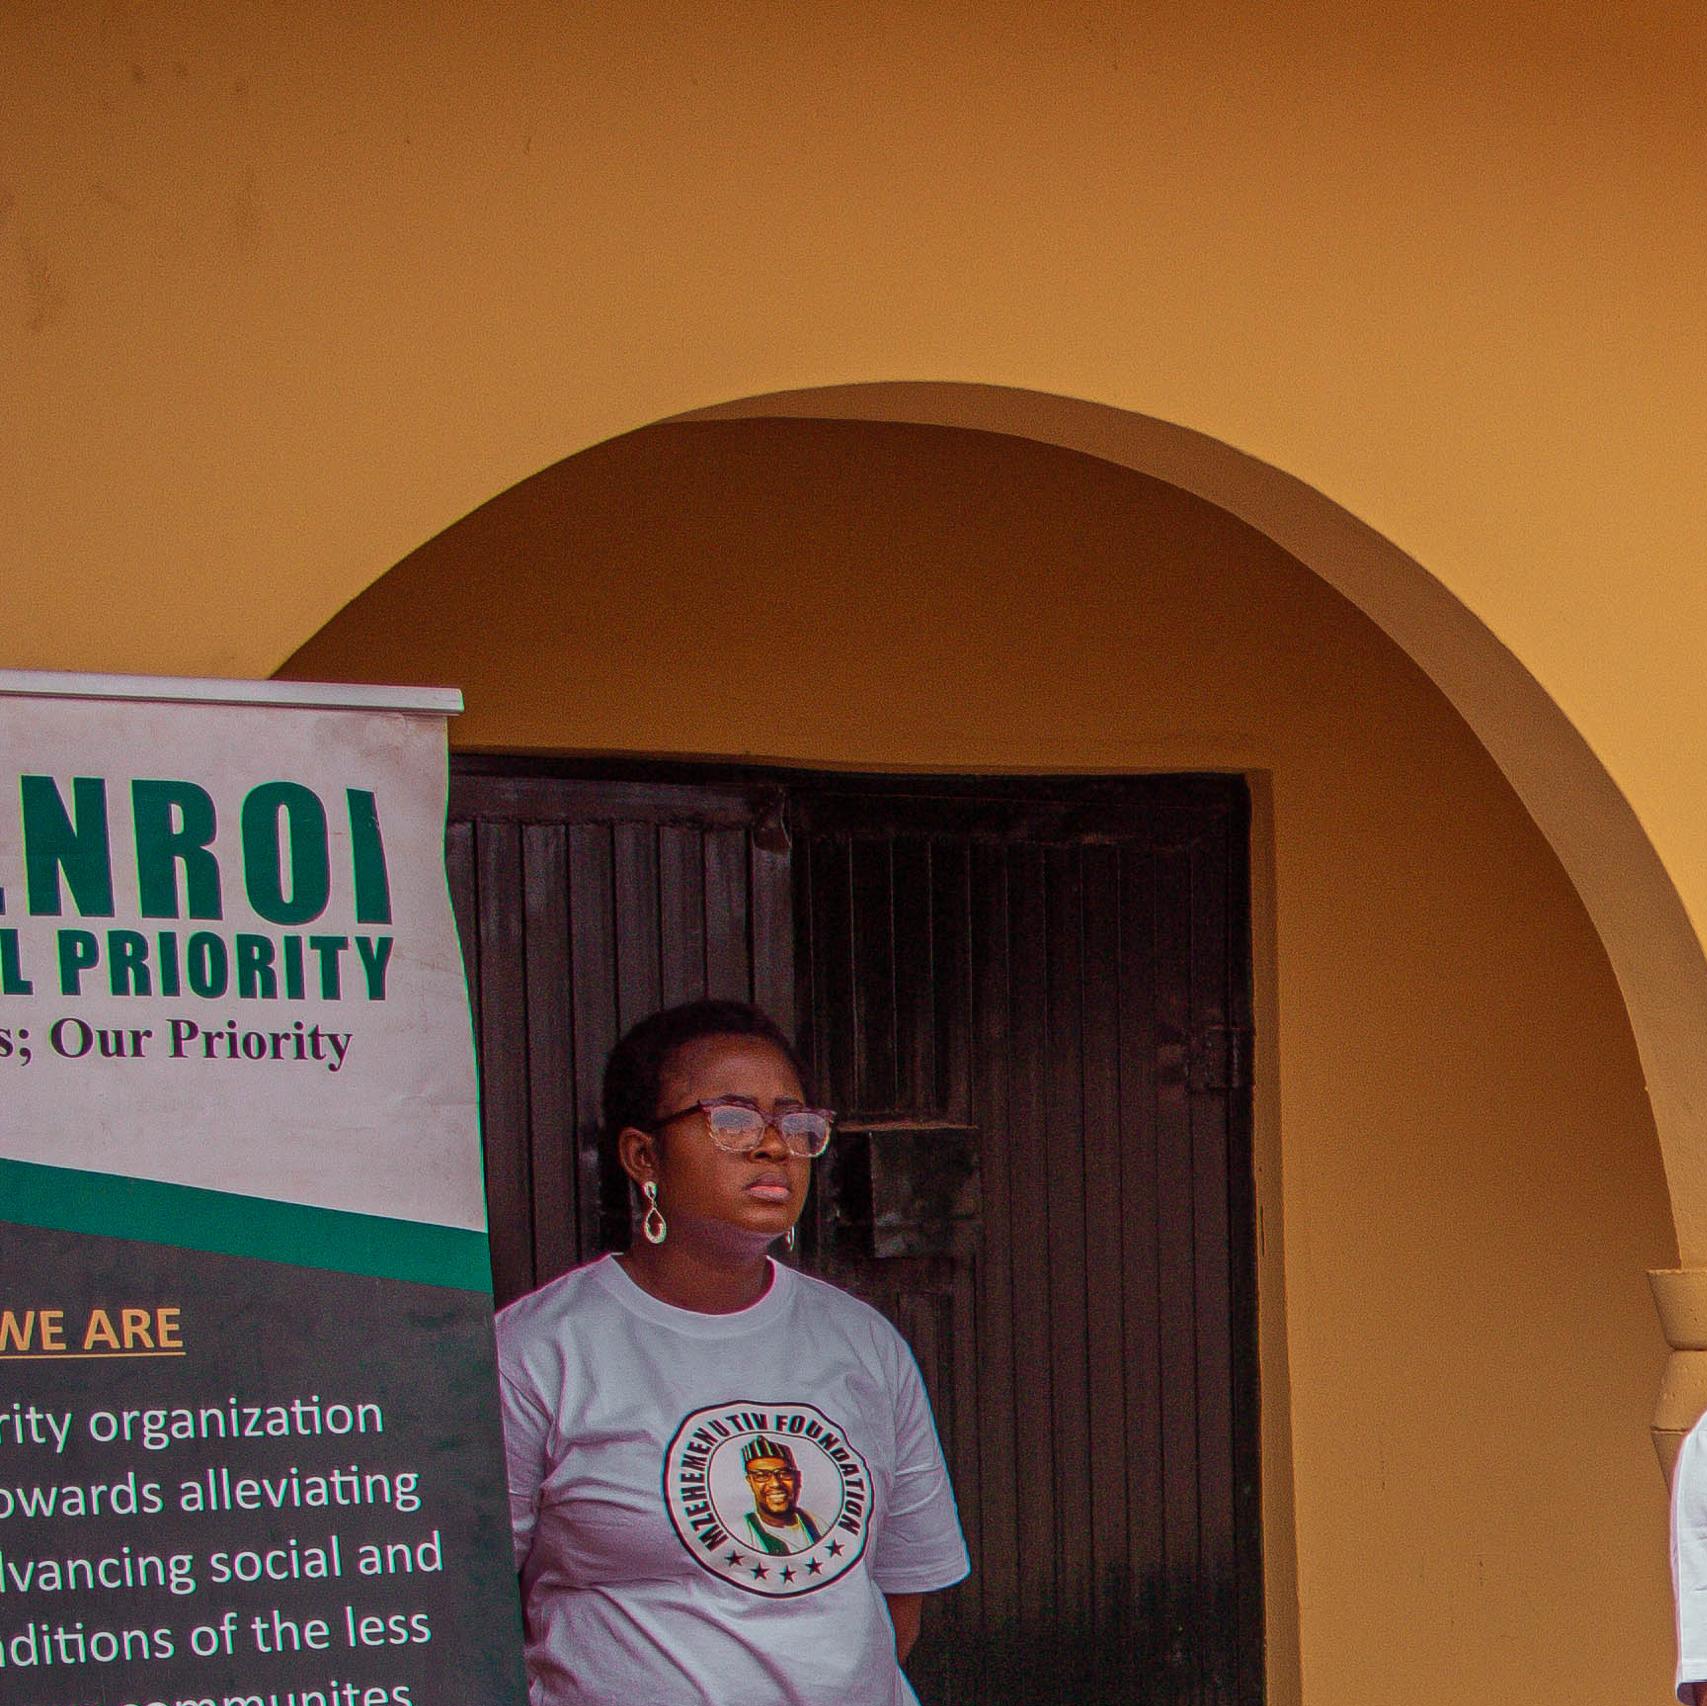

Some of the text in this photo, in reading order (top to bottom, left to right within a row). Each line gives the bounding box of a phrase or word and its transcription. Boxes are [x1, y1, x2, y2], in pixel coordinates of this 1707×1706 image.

[0, 774, 393, 926] NROI
[57, 928, 394, 1001] PRIORITY
[50, 1017, 153, 1059] Our
[168, 1018, 353, 1072] Priority
[84, 1308, 183, 1351] ARE
[89, 1395, 385, 1450] organization
[180, 1465, 422, 1513] alleviating
[680, 1427, 729, 1553] MZEHEMEN
[707, 1420, 731, 1438] U
[775, 1414, 866, 1537] FOUNDATION
[211, 1535, 342, 1585] social
[358, 1530, 444, 1575] and
[191, 1612, 238, 1657] of
[250, 1611, 331, 1654] the
[346, 1606, 432, 1649] less
